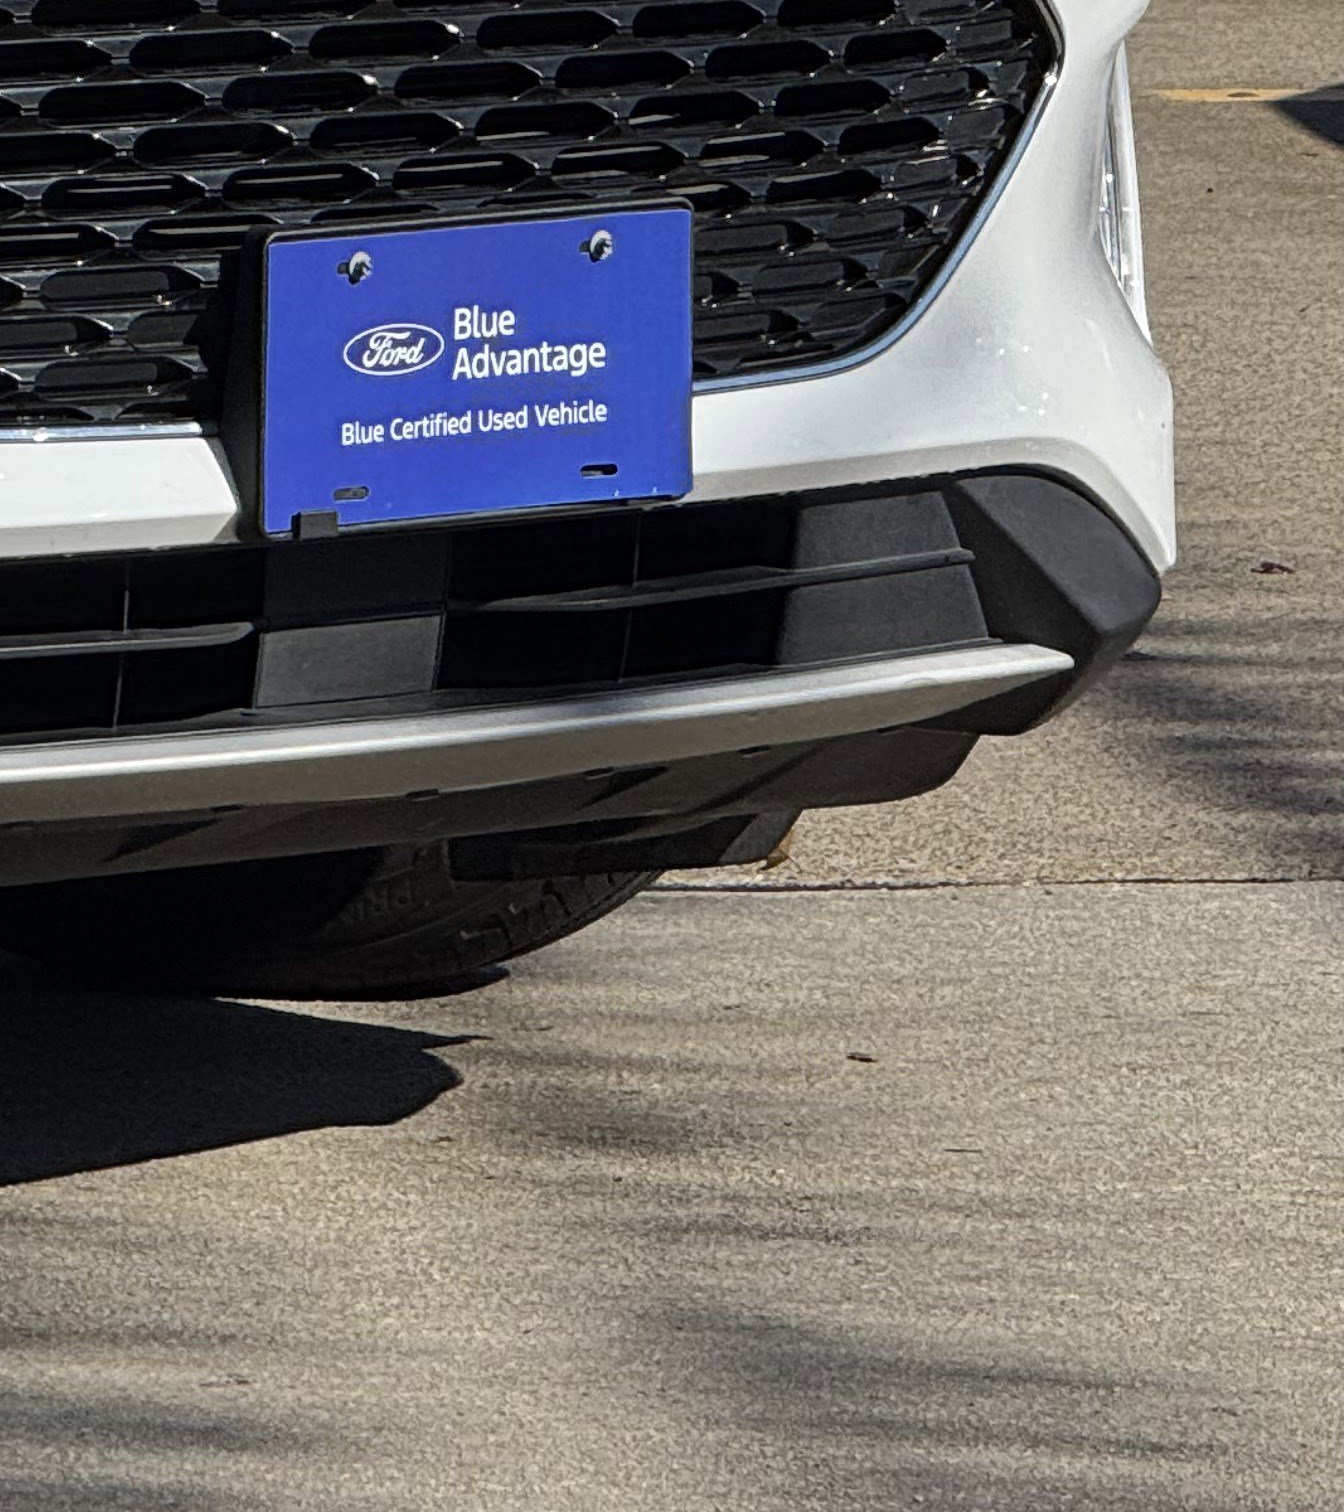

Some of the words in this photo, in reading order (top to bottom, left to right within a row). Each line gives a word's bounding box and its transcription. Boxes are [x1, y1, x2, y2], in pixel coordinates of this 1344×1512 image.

[453, 304, 516, 341] Blue
[362, 330, 426, 369] Ford
[451, 341, 607, 381] Advantage
[340, 422, 385, 447] Blue
[389, 411, 472, 441] Certified
[478, 404, 529, 433] Used
[534, 398, 608, 428] Vehicle
